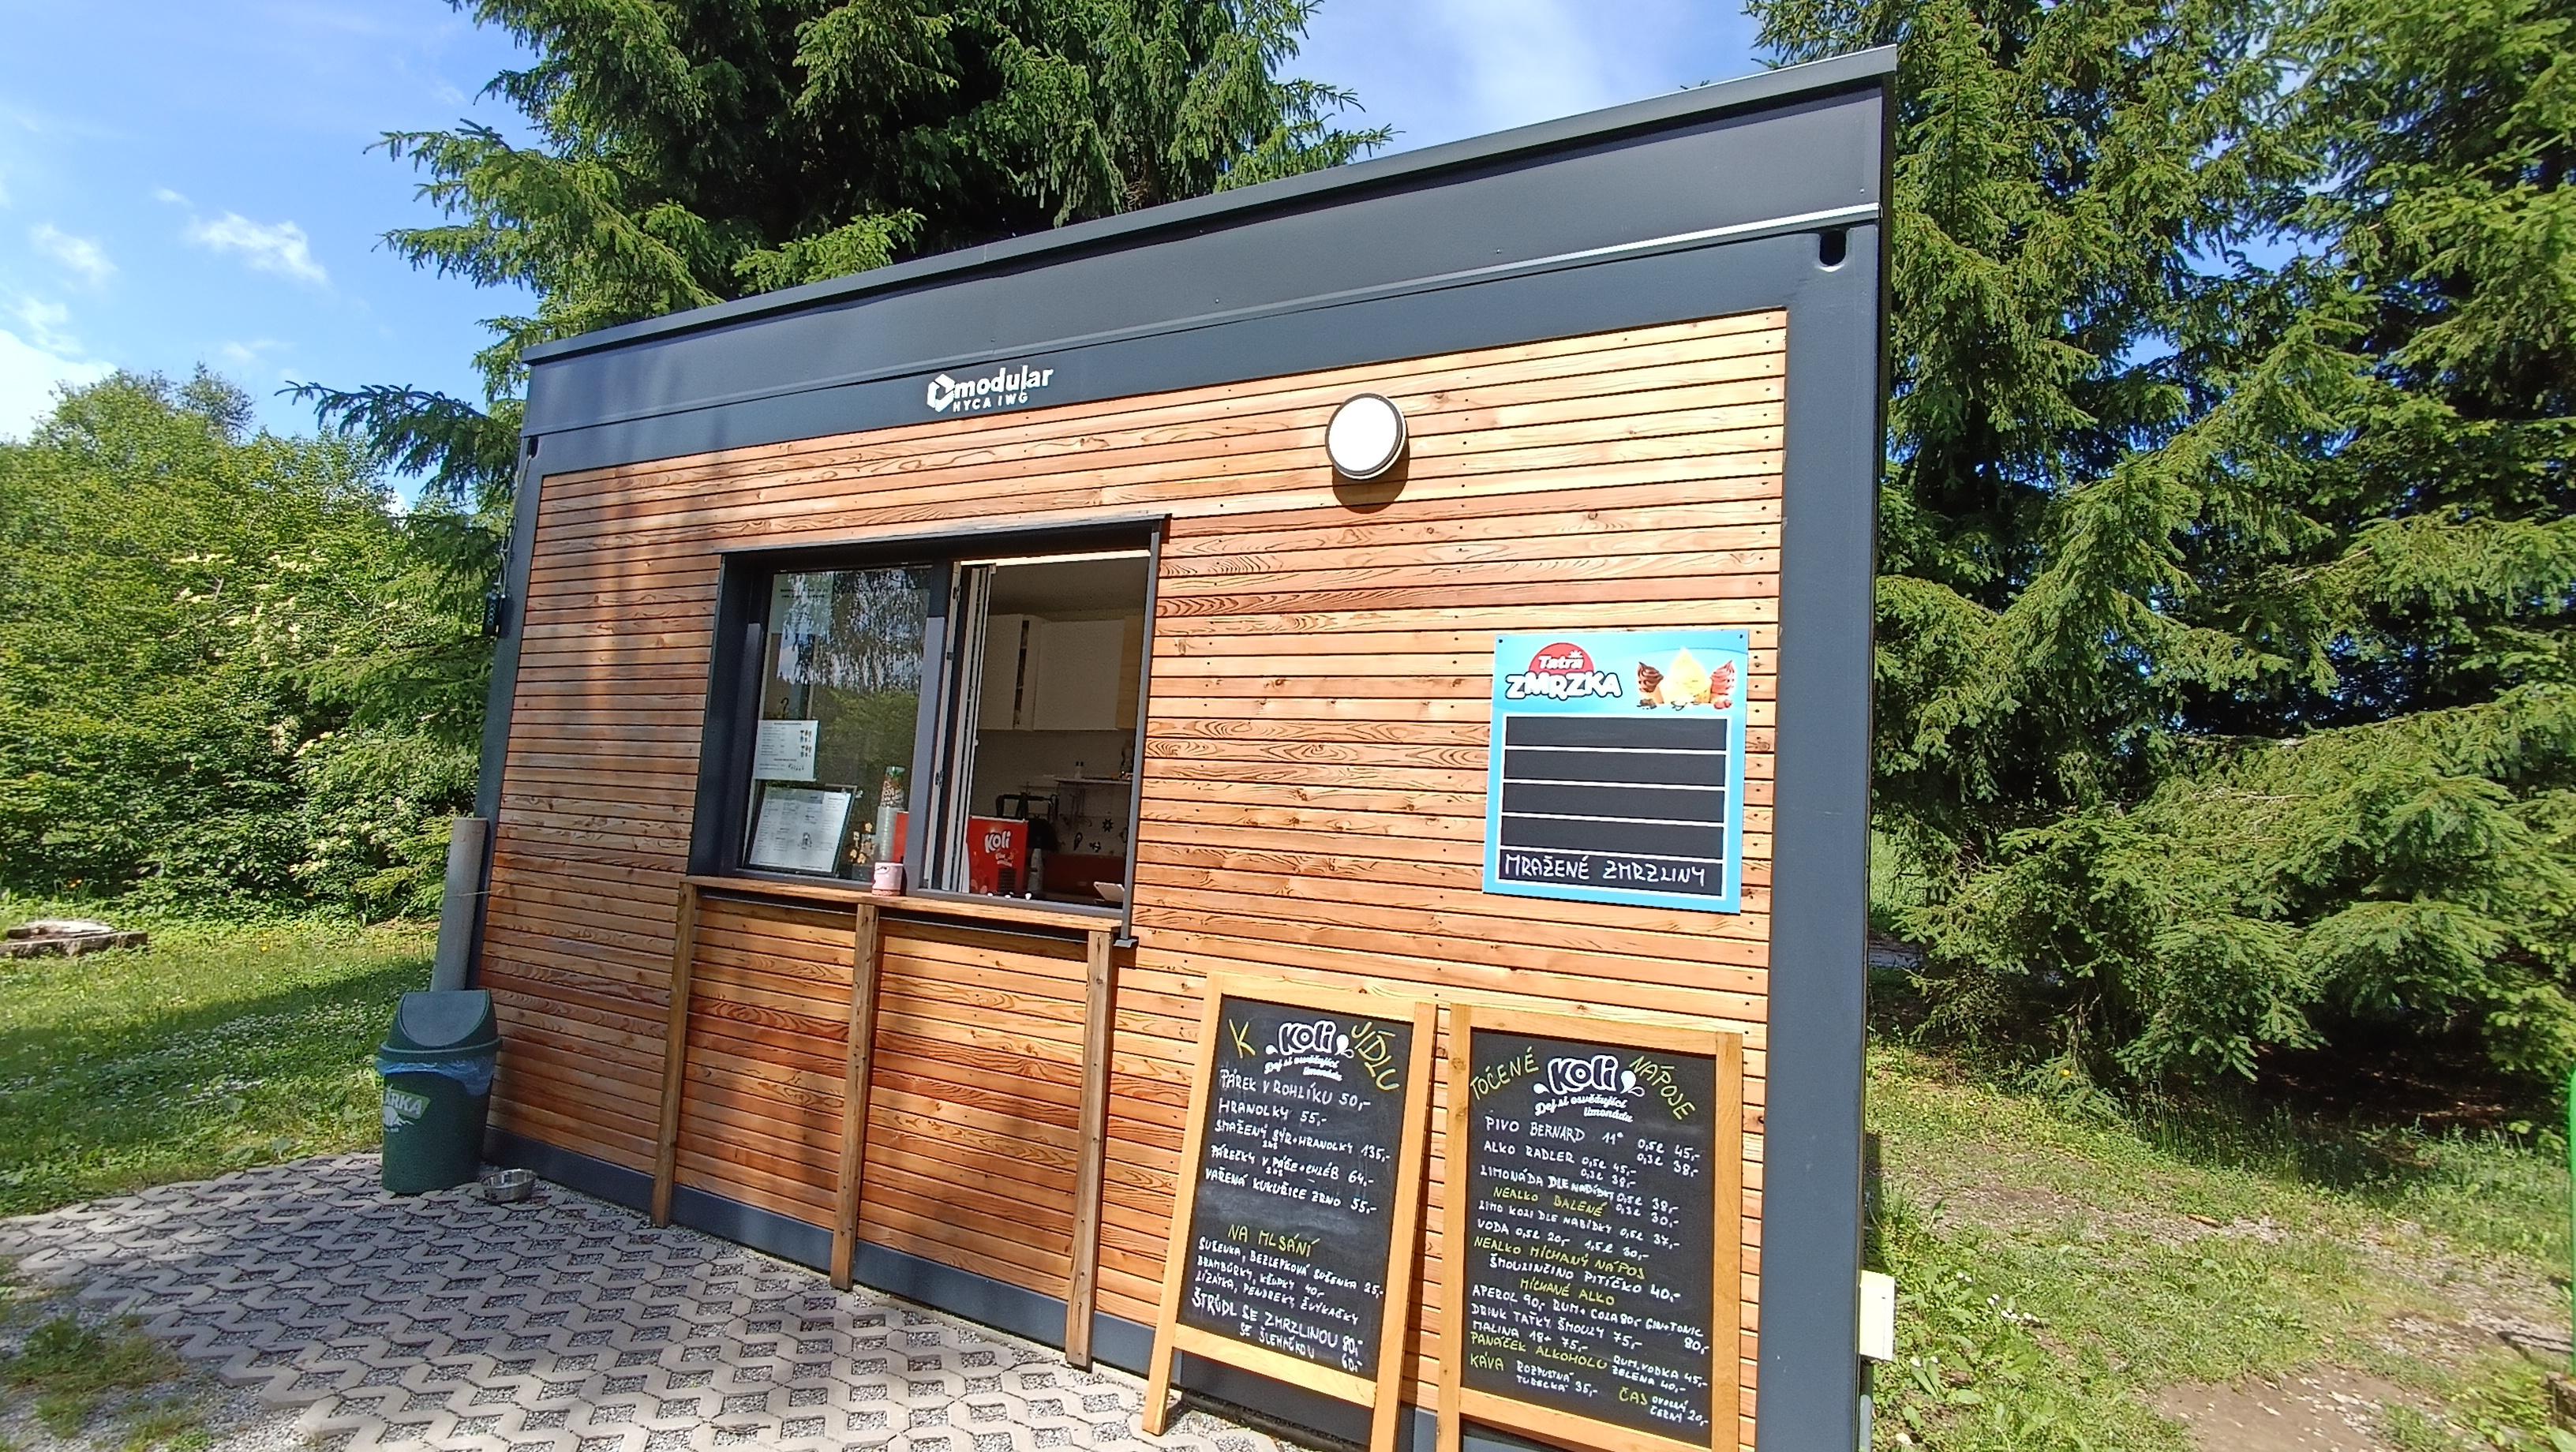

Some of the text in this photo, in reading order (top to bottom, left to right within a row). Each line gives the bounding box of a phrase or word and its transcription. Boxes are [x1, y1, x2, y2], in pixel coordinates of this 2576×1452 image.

[954, 365, 1054, 399] modular
[953, 392, 1028, 412] HYCA IWG
[1538, 655, 1583, 669] Tatra
[1505, 671, 1623, 701] ZMRZKA
[984, 830, 1011, 853] Koli
[1504, 853, 1705, 887] MRAŽENÉ ZMRZLINY
[1229, 1019, 1256, 1058] K
[1470, 1046, 1540, 1101] TOČENÉ
[1219, 1068, 1256, 1092] PÁREK
[1273, 1082, 1333, 1105] ROHLÍKU
[1339, 1093, 1371, 1111] 50,-
[1219, 1098, 1327, 1127] HRANOLKY 55,-
[1534, 1098, 1556, 1116] Dej
[1556, 1096, 1569, 1107] si
[1215, 1118, 1267, 1138] SMAŽENÝ
[1361, 1144, 1391, 1162] 135,-
[1484, 1141, 1515, 1155] ALKO
[1526, 1145, 1575, 1164] RADLER
[1485, 1116, 1520, 1133] PIVO
[1530, 1121, 1585, 1143] BERNARD
[1675, 1143, 1701, 1160] 45,-
[1480, 1166, 1543, 1188] LIMONÁDA
[1548, 1176, 1569, 1189] DLE
[1673, 1159, 1698, 1177] 38,-
[1205, 1167, 1377, 1214] VAŘENÁ KUKUŘICE ZRNO 55,-
[1493, 1187, 1608, 1217] NEALKO BALENÉ
[1477, 1218, 1509, 1235] VODA
[1478, 1199, 1503, 1213] LIMO
[1538, 1210, 1557, 1223] DLE
[1563, 1215, 1612, 1233] NABÍDKY
[1228, 1224, 1320, 1258] NA MLSÁNÍ
[1473, 1236, 1645, 1279] NEALKO MÍCHANÝ NÁPOJ
[1520, 1277, 1615, 1305] MÍCHANÉ ALKO
[1584, 1270, 1642, 1293] PITÍČKO
[1472, 1284, 1518, 1303] APEROL
[1590, 1309, 1618, 1323] COLA
[1472, 1304, 1506, 1320] DRINK
[1240, 1322, 1252, 1337] SE
[1241, 1304, 1258, 1322] SE
[1264, 1312, 1339, 1348] ZMRZLINOU
[1473, 1321, 1519, 1338] MALINA
[1470, 1331, 1608, 1370] PANÁČEK ALKOHOLU
[1470, 1352, 1504, 1372] KÁVA
[1642, 1361, 1679, 1379] VODKA
[1619, 1387, 1648, 1405] ČAJ
